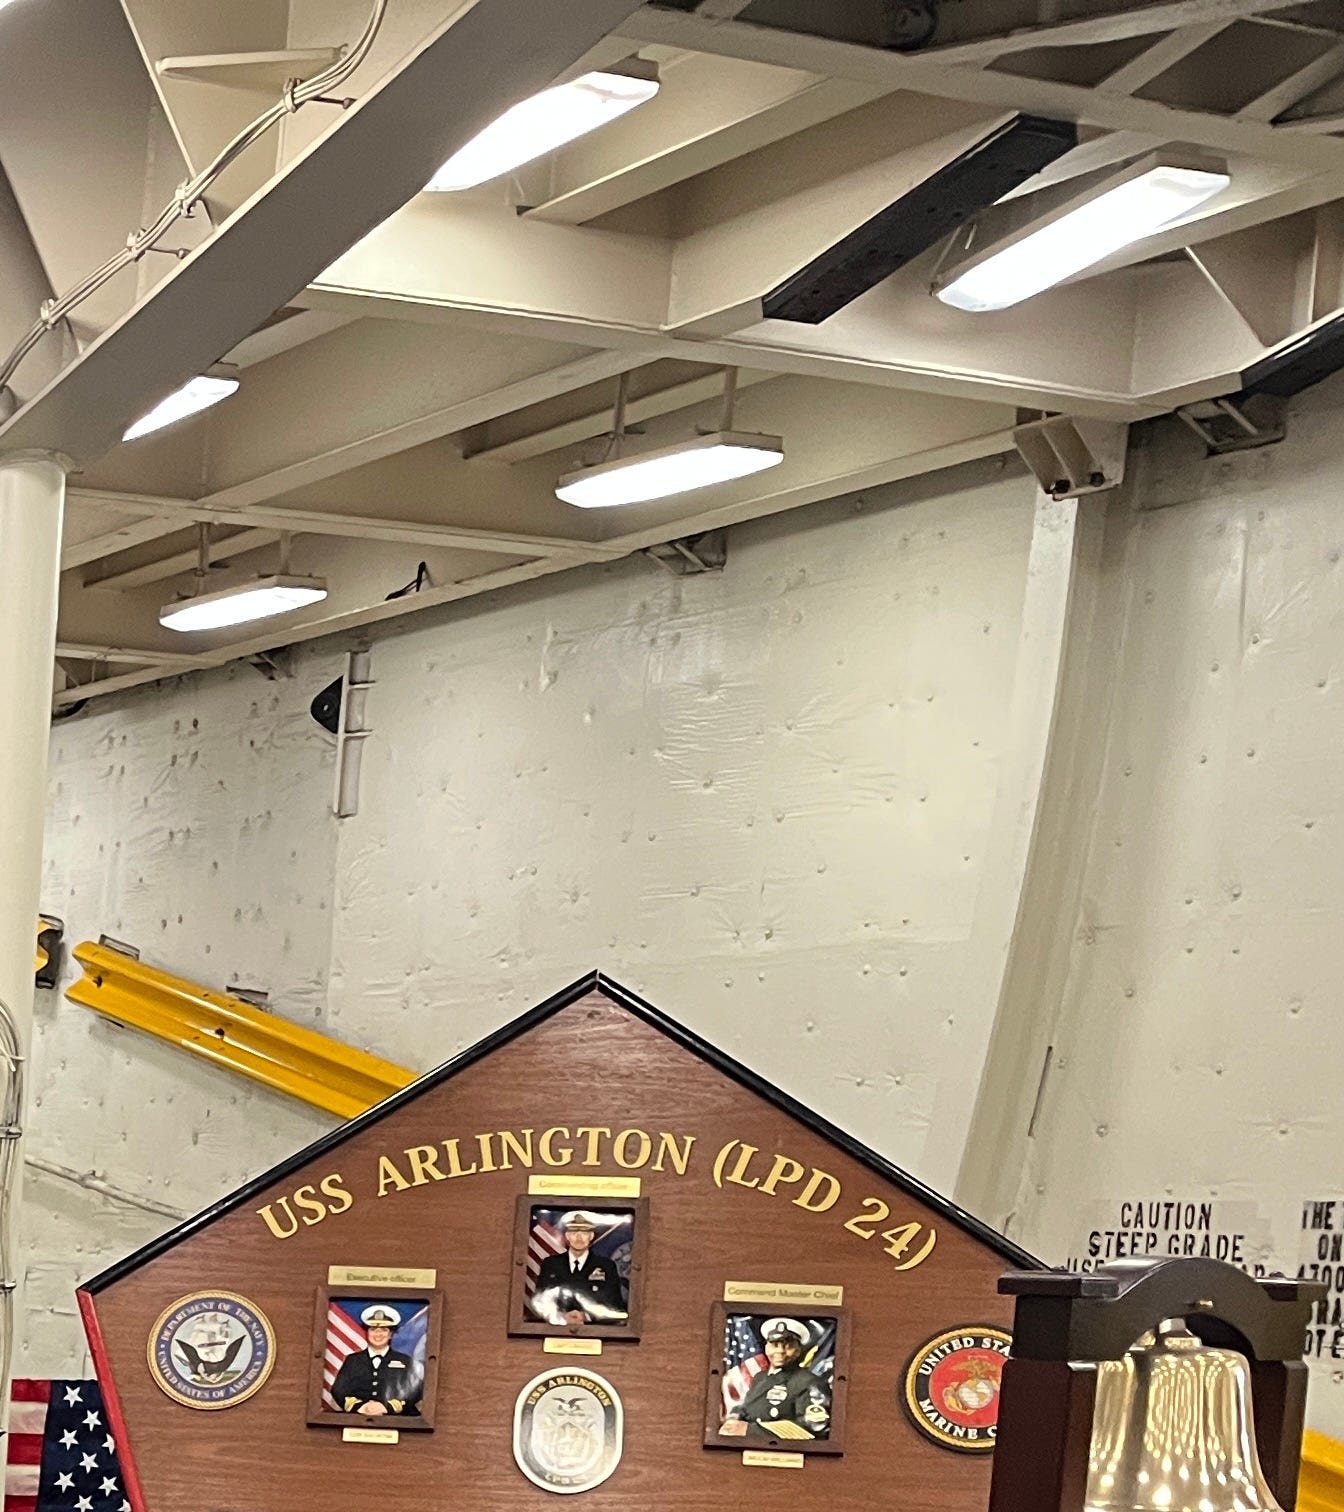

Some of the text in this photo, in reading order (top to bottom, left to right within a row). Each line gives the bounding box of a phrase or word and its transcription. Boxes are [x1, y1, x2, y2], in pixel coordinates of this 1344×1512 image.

[256, 1127, 937, 1272] USS ARLINGTON (LPD 24)
[1120, 1202, 1212, 1230] CAUTION
[727, 1286, 840, 1301] Command Master Chief
[919, 1337, 975, 1376] UNITED
[548, 1376, 612, 1407] ARLINGTON
[919, 1398, 979, 1440] MARINE
